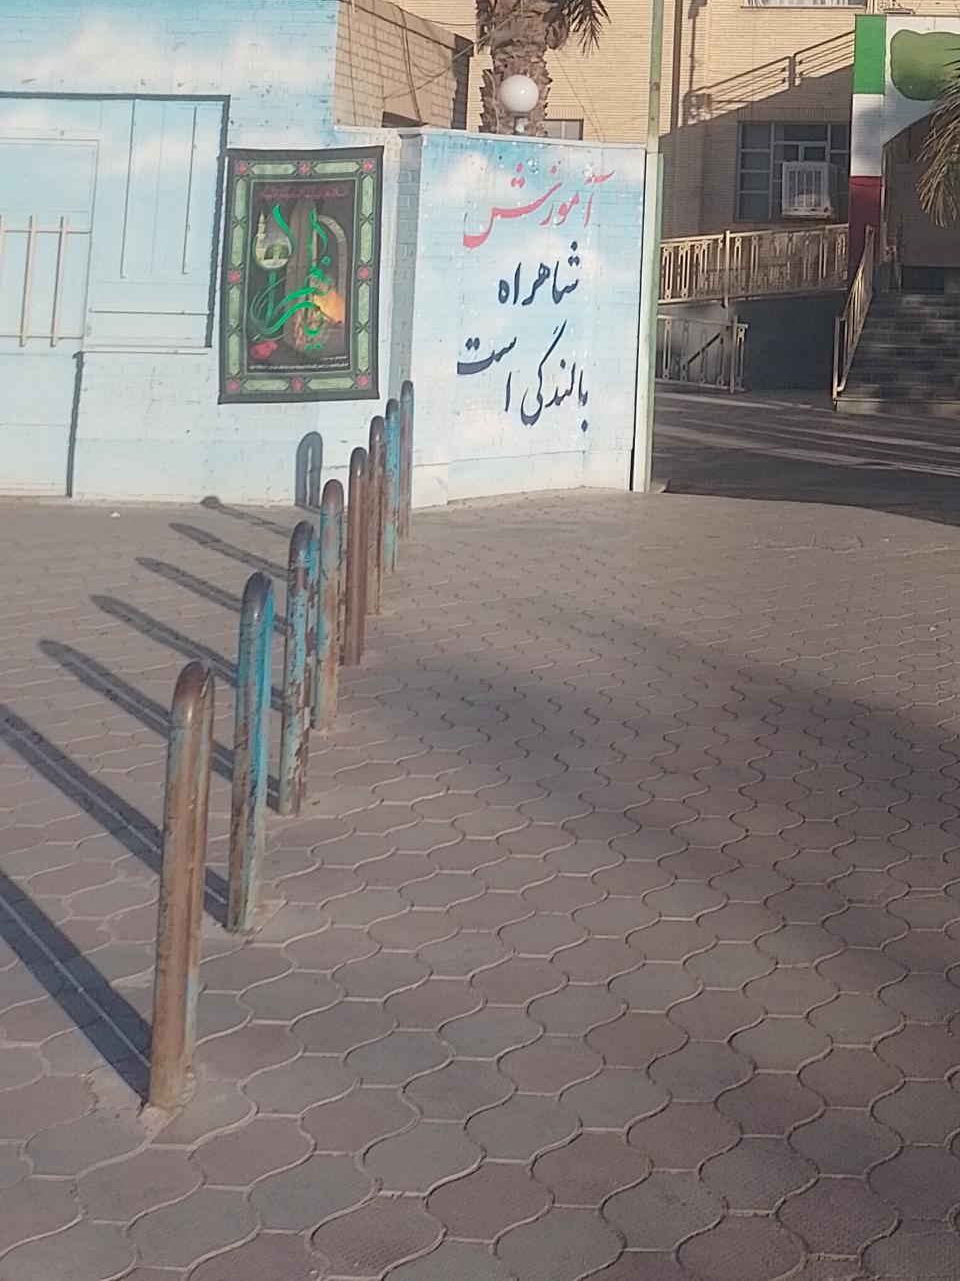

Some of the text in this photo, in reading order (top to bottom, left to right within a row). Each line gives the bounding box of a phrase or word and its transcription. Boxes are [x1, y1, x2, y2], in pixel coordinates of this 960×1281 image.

[463, 162, 616, 250] آموزش
[498, 240, 580, 305] شاهراه
[456, 336, 517, 412] است
